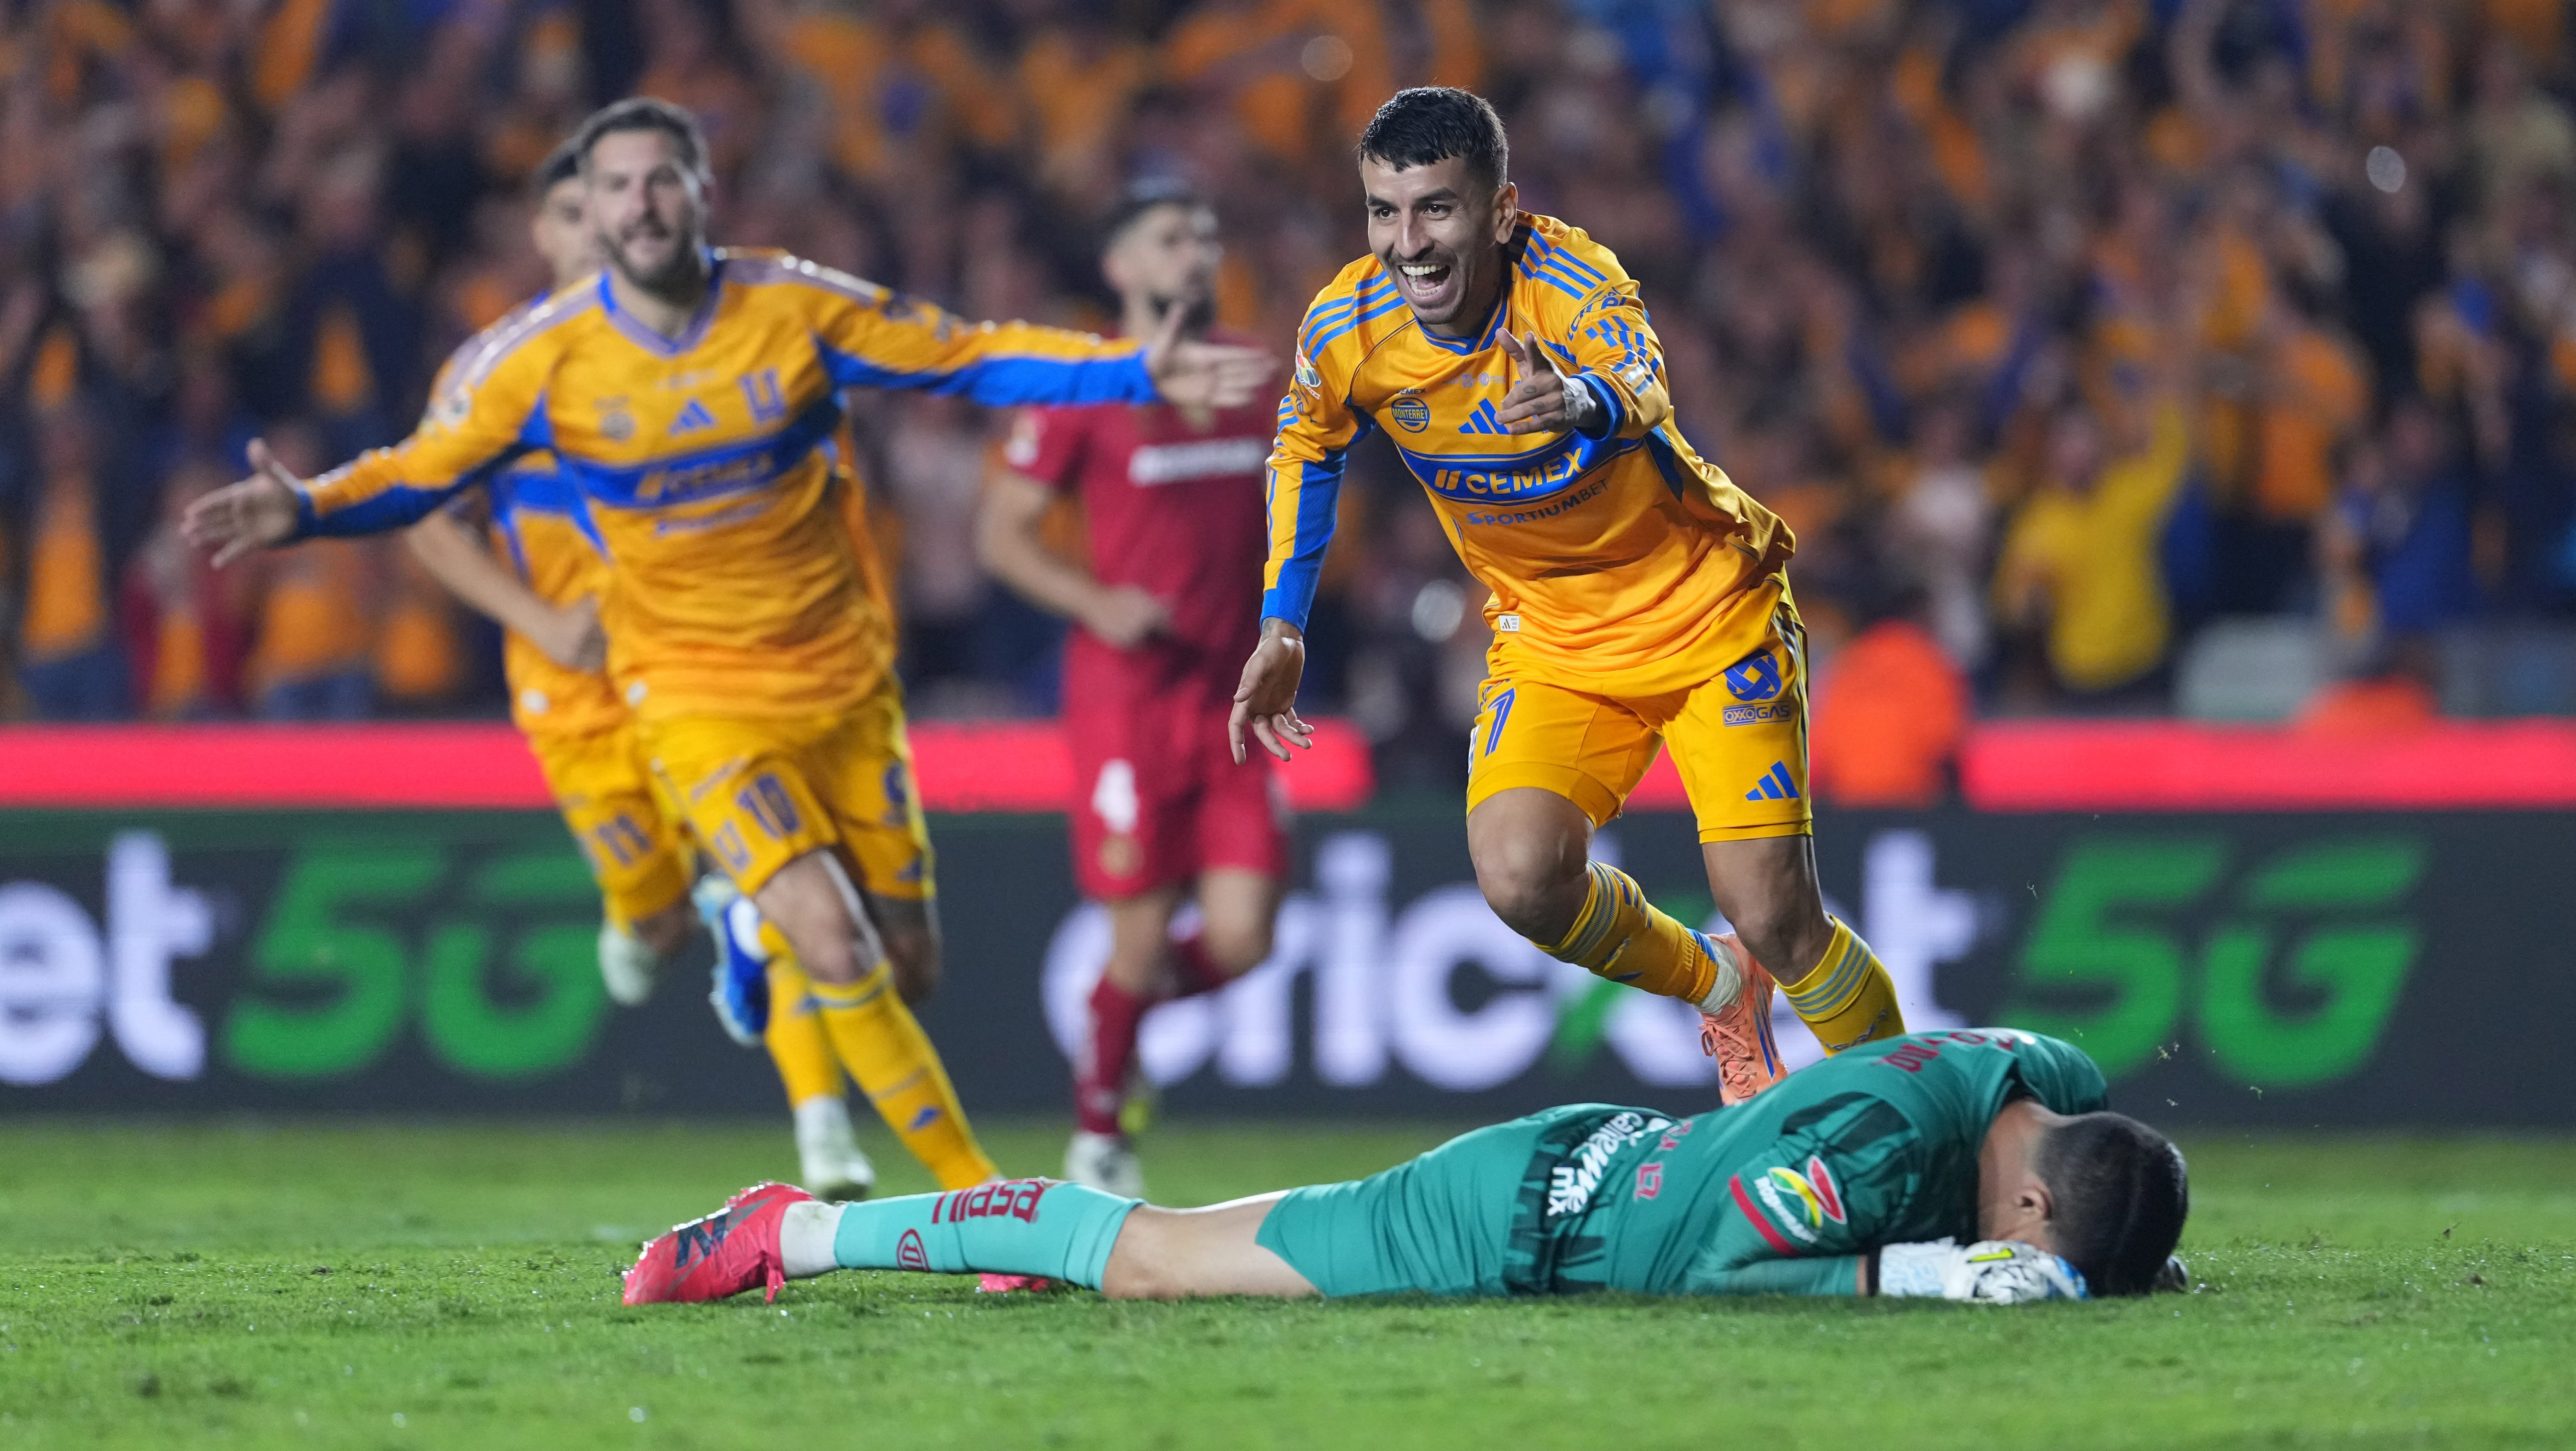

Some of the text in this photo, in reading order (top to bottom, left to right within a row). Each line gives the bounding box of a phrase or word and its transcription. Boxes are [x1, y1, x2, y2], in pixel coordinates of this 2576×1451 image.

[1392, 408, 1428, 420] MONTERREY
[1465, 447, 1586, 495] CEMEX
[1756, 705, 1791, 719] GAS
[736, 771, 801, 841] 10
[224, 841, 611, 1082] 5G
[1992, 833, 2428, 1087] 5G
